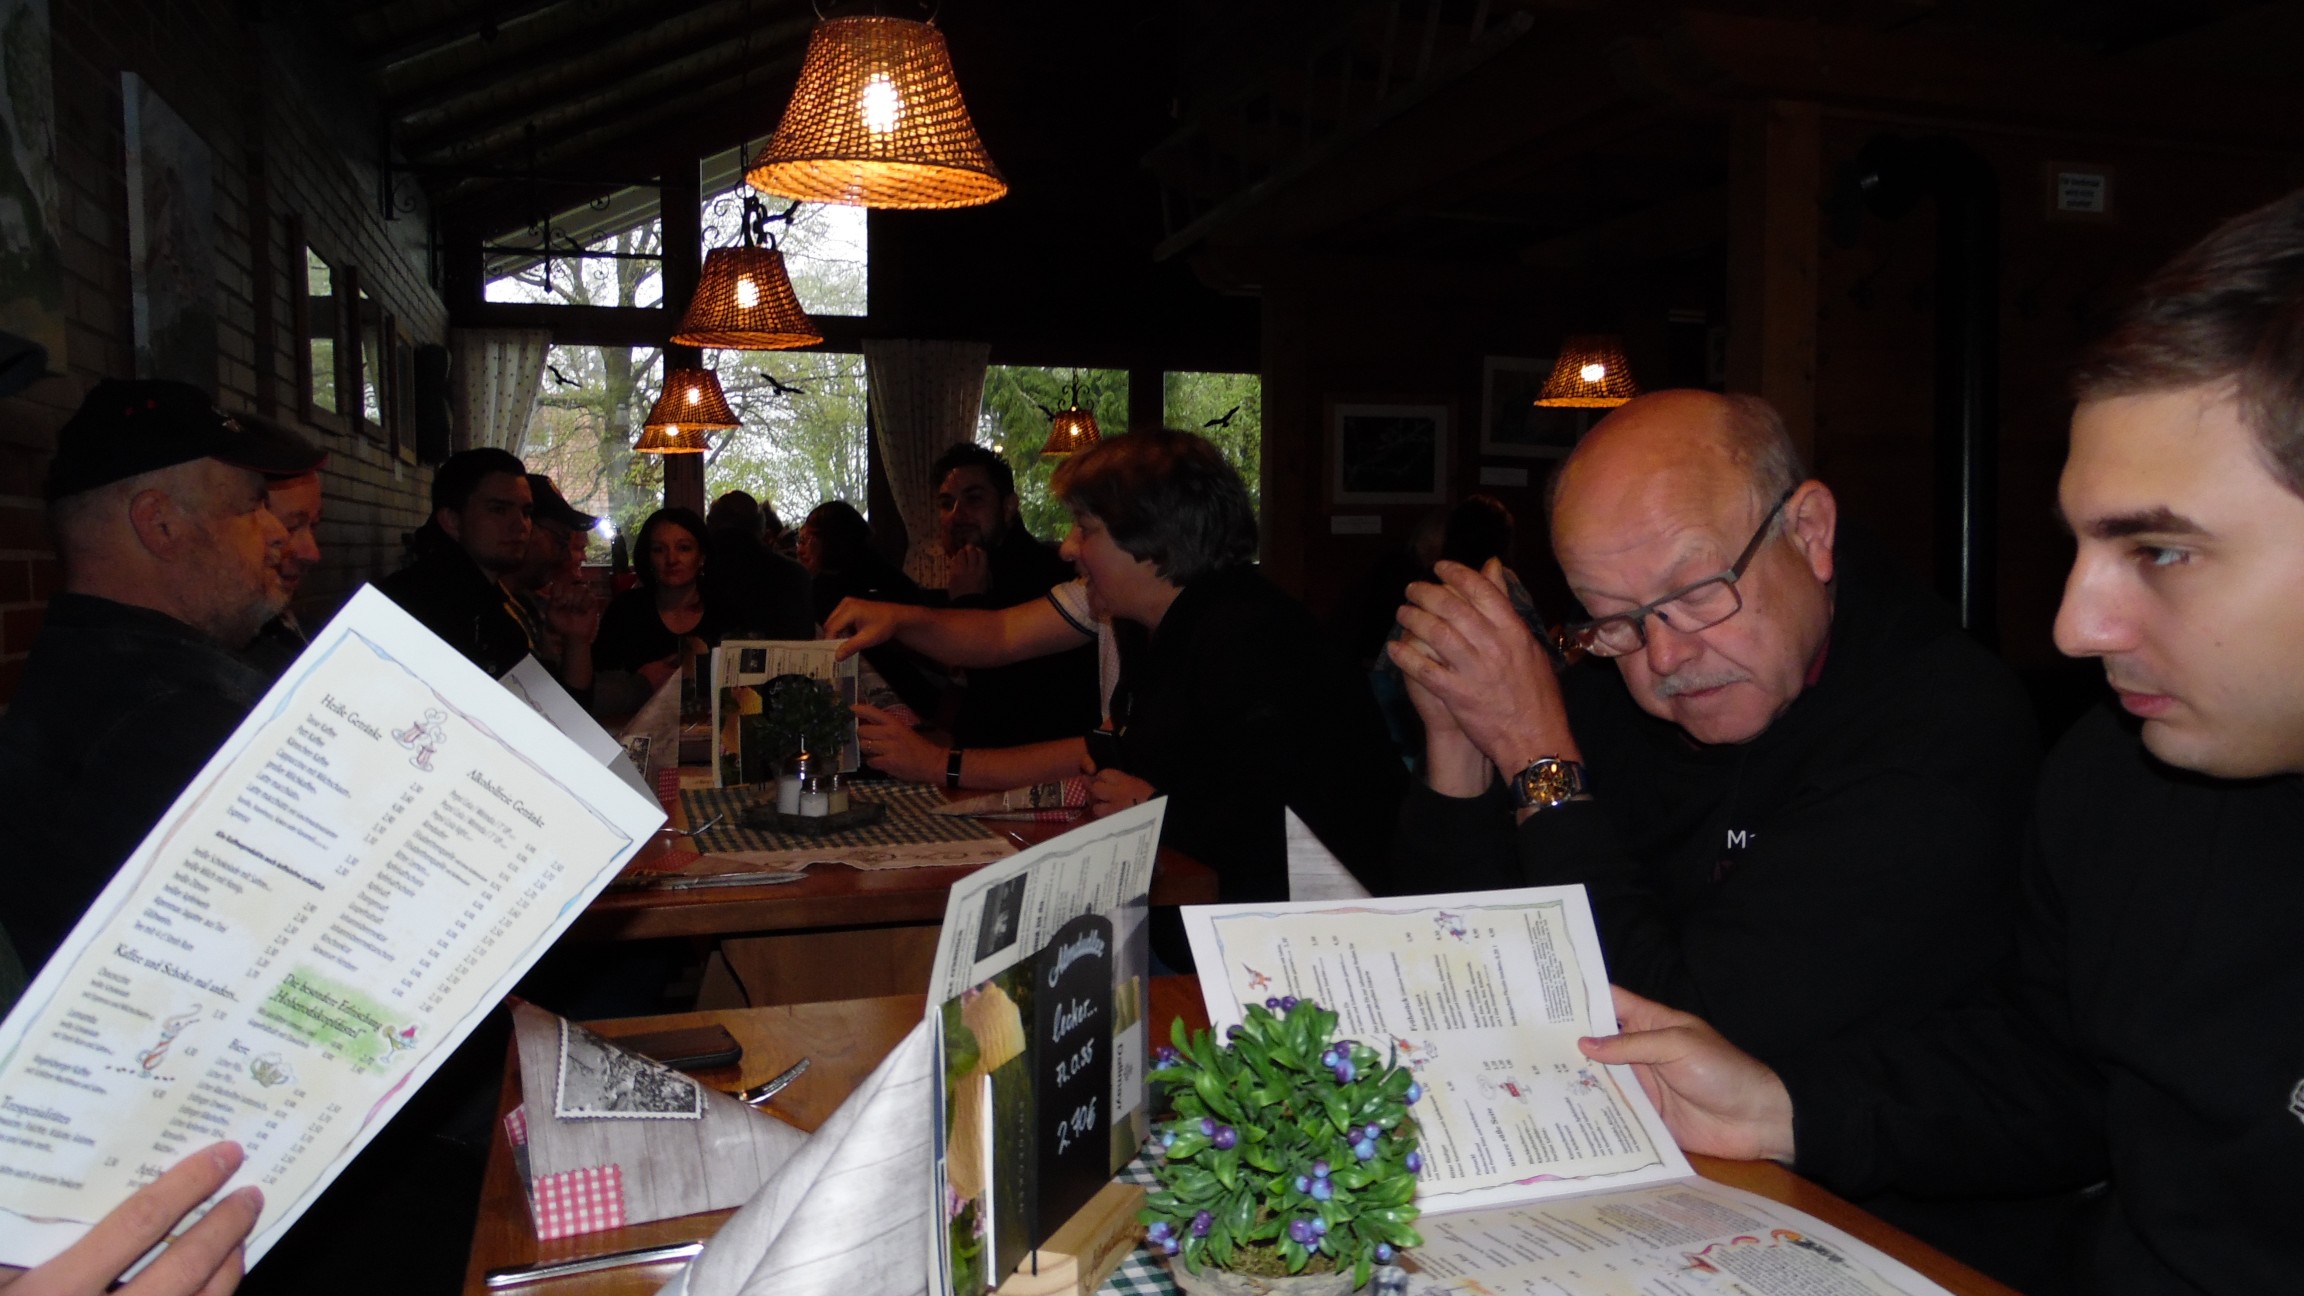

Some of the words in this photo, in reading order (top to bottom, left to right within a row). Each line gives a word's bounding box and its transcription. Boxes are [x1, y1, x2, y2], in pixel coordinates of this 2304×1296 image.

[320, 692, 351, 718] Heiße
[345, 710, 385, 742] Getränke
[465, 767, 515, 805] Alkoholfreie
[510, 799, 548, 829] Getränke
[112, 942, 147, 965] Kaffee
[142, 954, 165, 971] und
[159, 961, 196, 984] Schoko
[192, 974, 213, 990] mal
[282, 973, 303, 989] Die
[298, 980, 341, 1007] besondere
[334, 999, 387, 1033] Erfrischung
[227, 1038, 253, 1055] Biere
[1114, 1042, 1124, 1111] Dallmayr
